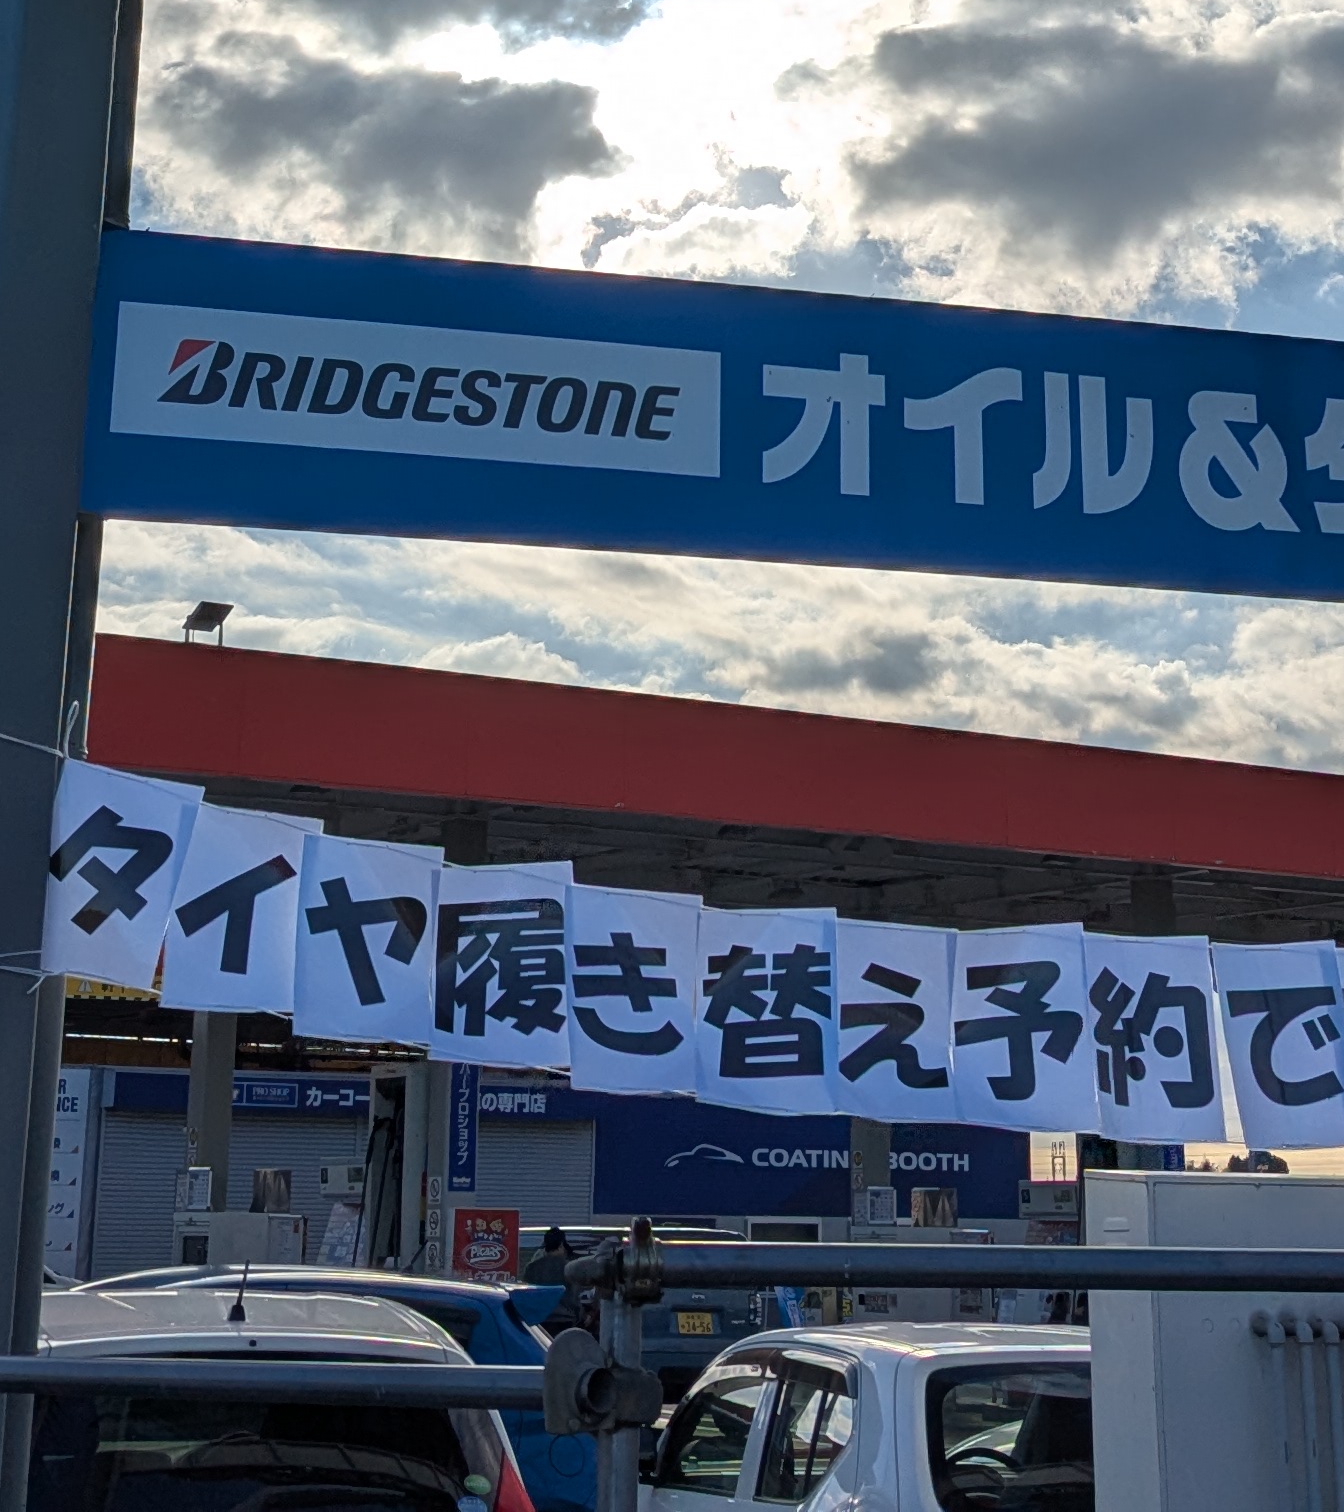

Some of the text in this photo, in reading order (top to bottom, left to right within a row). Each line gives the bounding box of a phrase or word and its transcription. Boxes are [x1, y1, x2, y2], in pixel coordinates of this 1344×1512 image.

[157, 338, 682, 442] BRIDGESTONE
[478, 1092, 548, 1114] の専門店
[751, 1148, 849, 1169] COATIN
